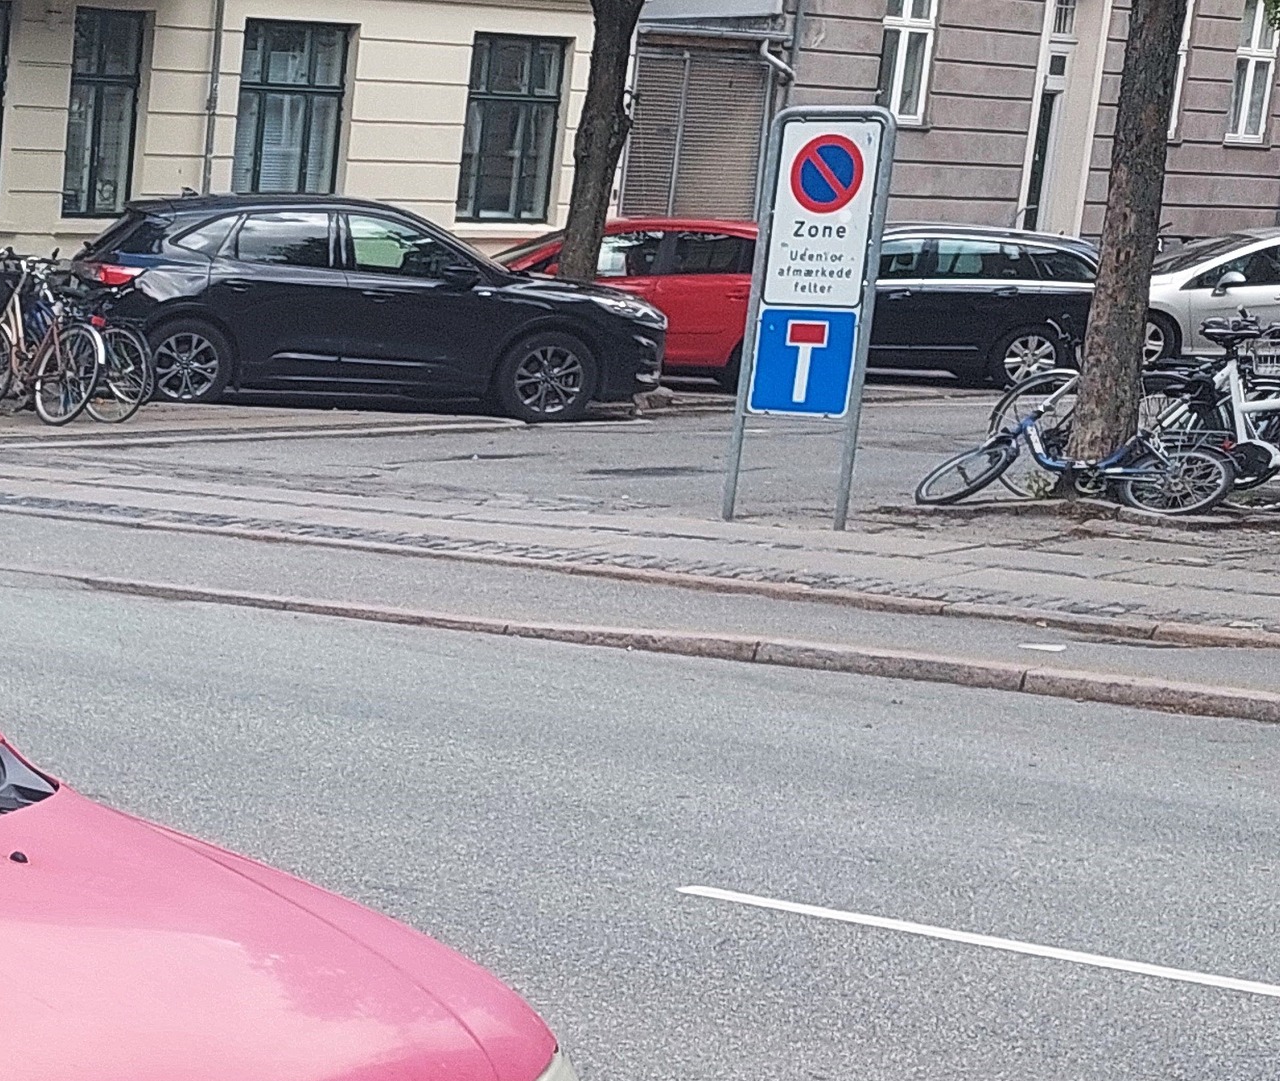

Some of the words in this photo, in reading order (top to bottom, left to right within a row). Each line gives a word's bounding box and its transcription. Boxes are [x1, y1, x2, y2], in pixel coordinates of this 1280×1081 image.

[793, 220, 847, 239] Zone
[777, 265, 852, 279] afmærkede
[793, 281, 833, 294] felter
